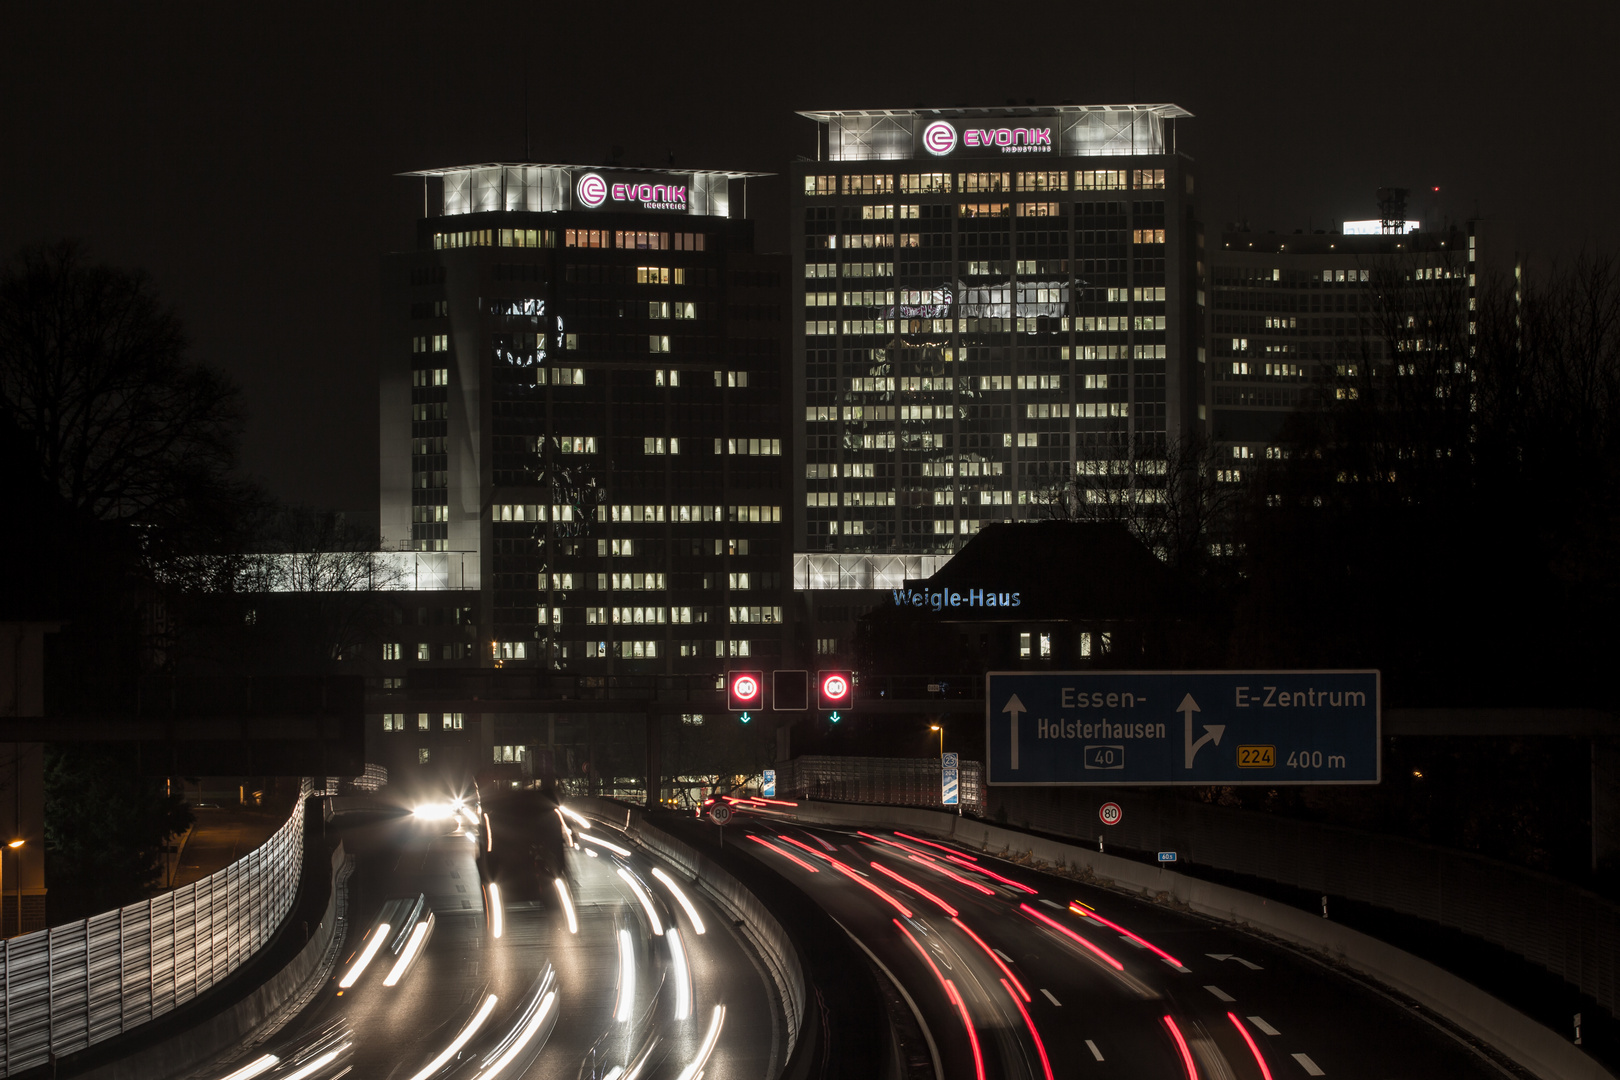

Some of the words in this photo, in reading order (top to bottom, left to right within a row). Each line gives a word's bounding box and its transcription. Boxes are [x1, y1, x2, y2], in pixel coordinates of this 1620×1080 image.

[963, 127, 1051, 147] EVONIK
[611, 184, 686, 203] EVONIK
[643, 202, 686, 210] INDUSTRIES
[892, 587, 1021, 612] Weigle-Haus
[1061, 687, 1147, 708] Essen-
[1235, 686, 1366, 708] E-Zentrum
[1037, 717, 1166, 740] Holsterhausen
[1094, 749, 1114, 765] 40
[1241, 749, 1271, 765] 224
[1286, 750, 1323, 769] 400
[1327, 755, 1346, 769] m
[715, 808, 727, 819] 80
[1104, 808, 1116, 819] 80
